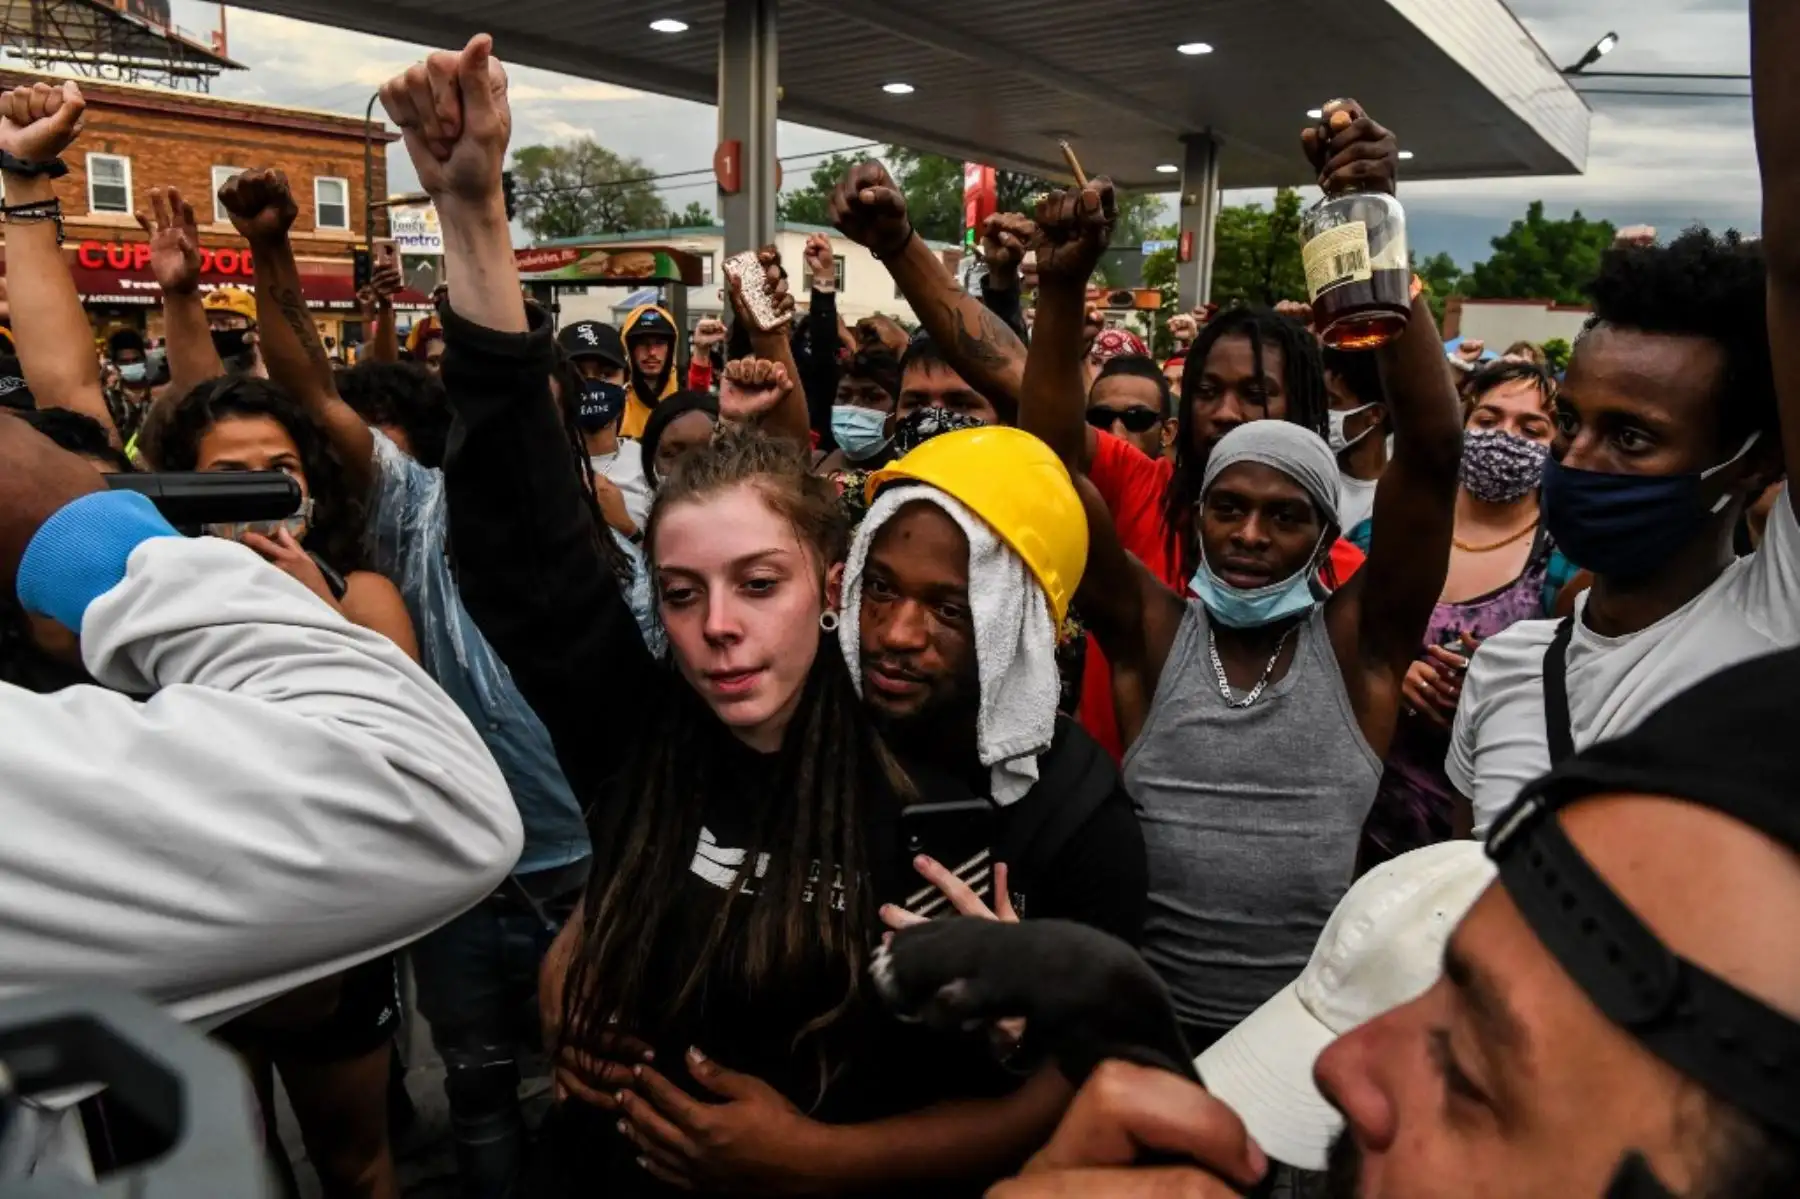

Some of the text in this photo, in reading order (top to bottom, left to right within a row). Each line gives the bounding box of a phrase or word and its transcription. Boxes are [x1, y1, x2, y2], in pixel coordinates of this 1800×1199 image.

[724, 155, 731, 175] 1
[395, 234, 441, 247] metro
[79, 241, 255, 275] CUP OOD
[580, 404, 609, 415] EATHE
